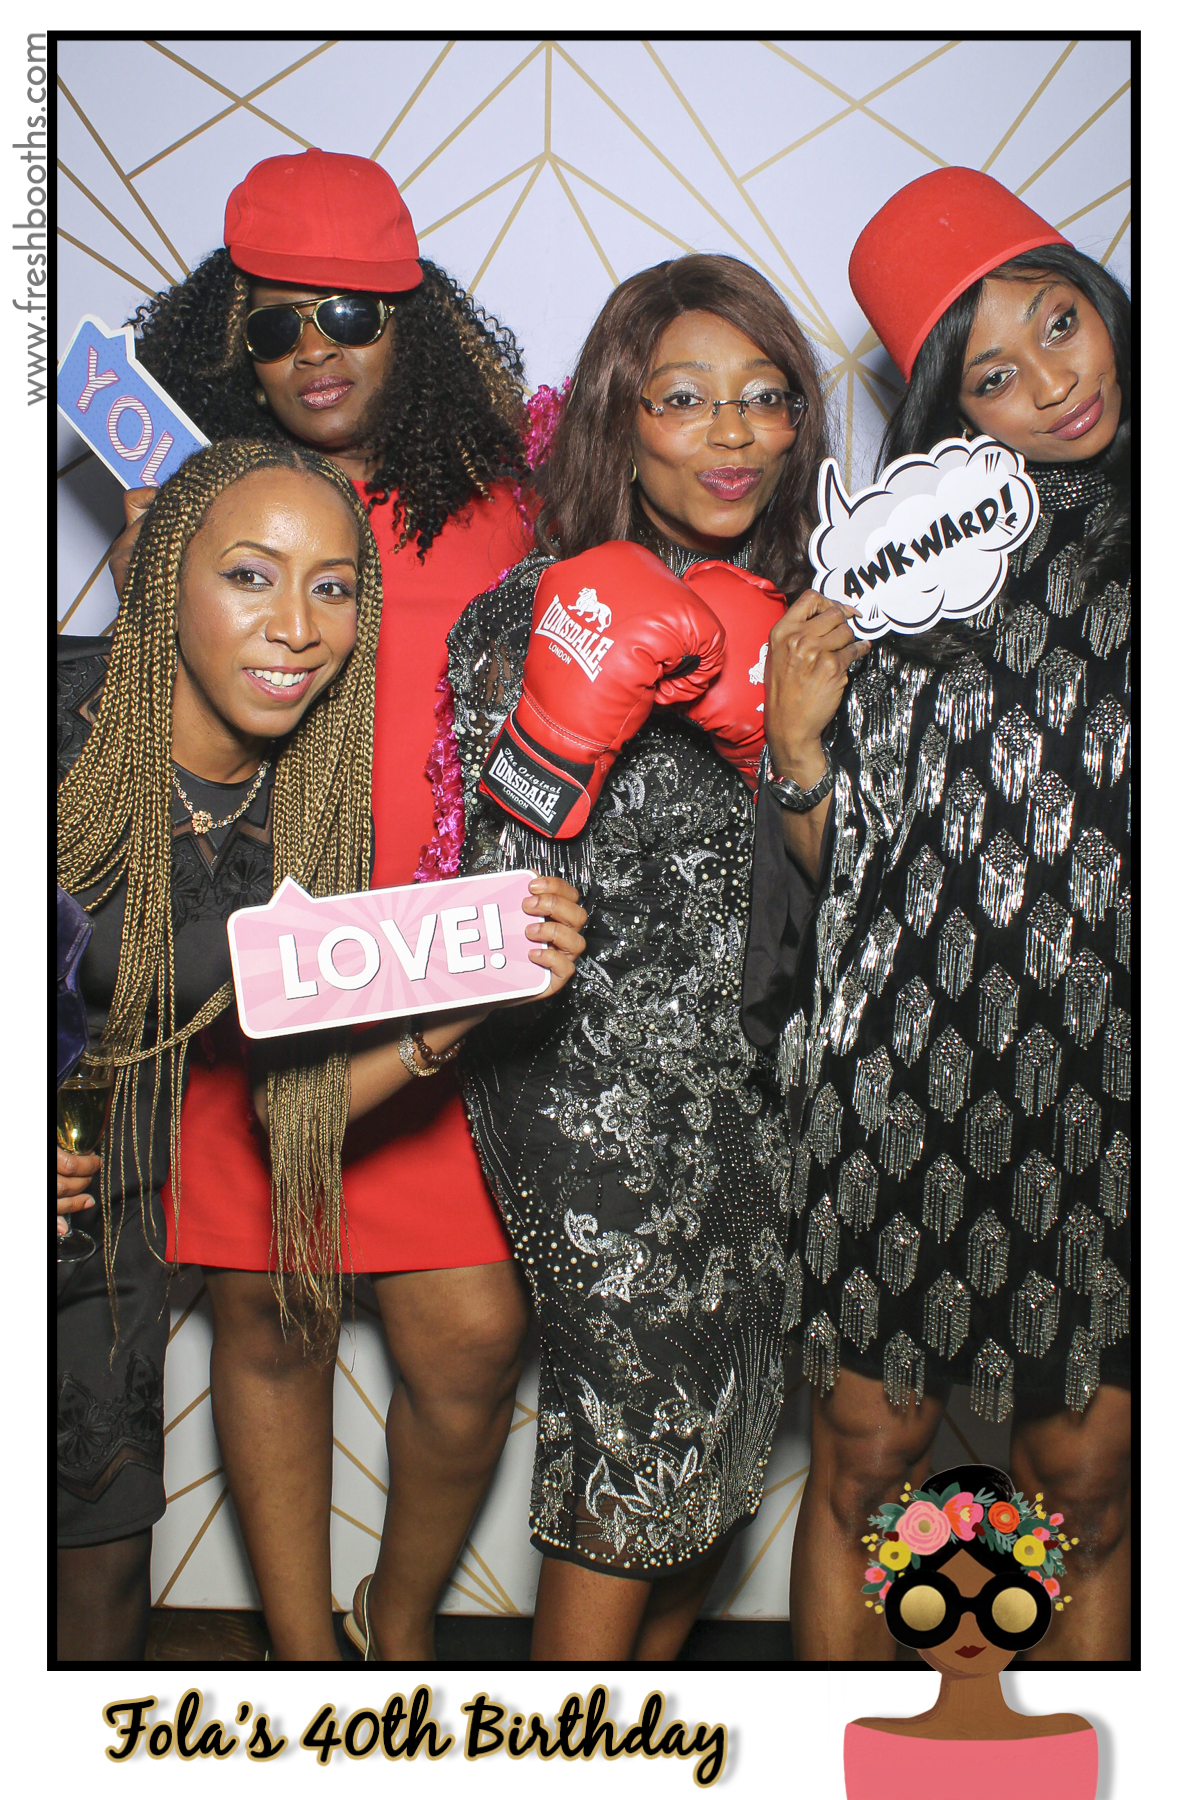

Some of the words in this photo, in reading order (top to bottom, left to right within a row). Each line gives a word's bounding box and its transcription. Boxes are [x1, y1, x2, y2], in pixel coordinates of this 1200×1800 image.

[843, 482, 1018, 599] AWKWARD!
[535, 594, 614, 682] LONSDALE
[548, 641, 572, 665] LONDON
[489, 748, 560, 823] LONSDALE
[503, 786, 529, 810] LONDON
[504, 747, 518, 767] The
[518, 766, 562, 794] Original
[278, 903, 507, 1000] LOVE!
